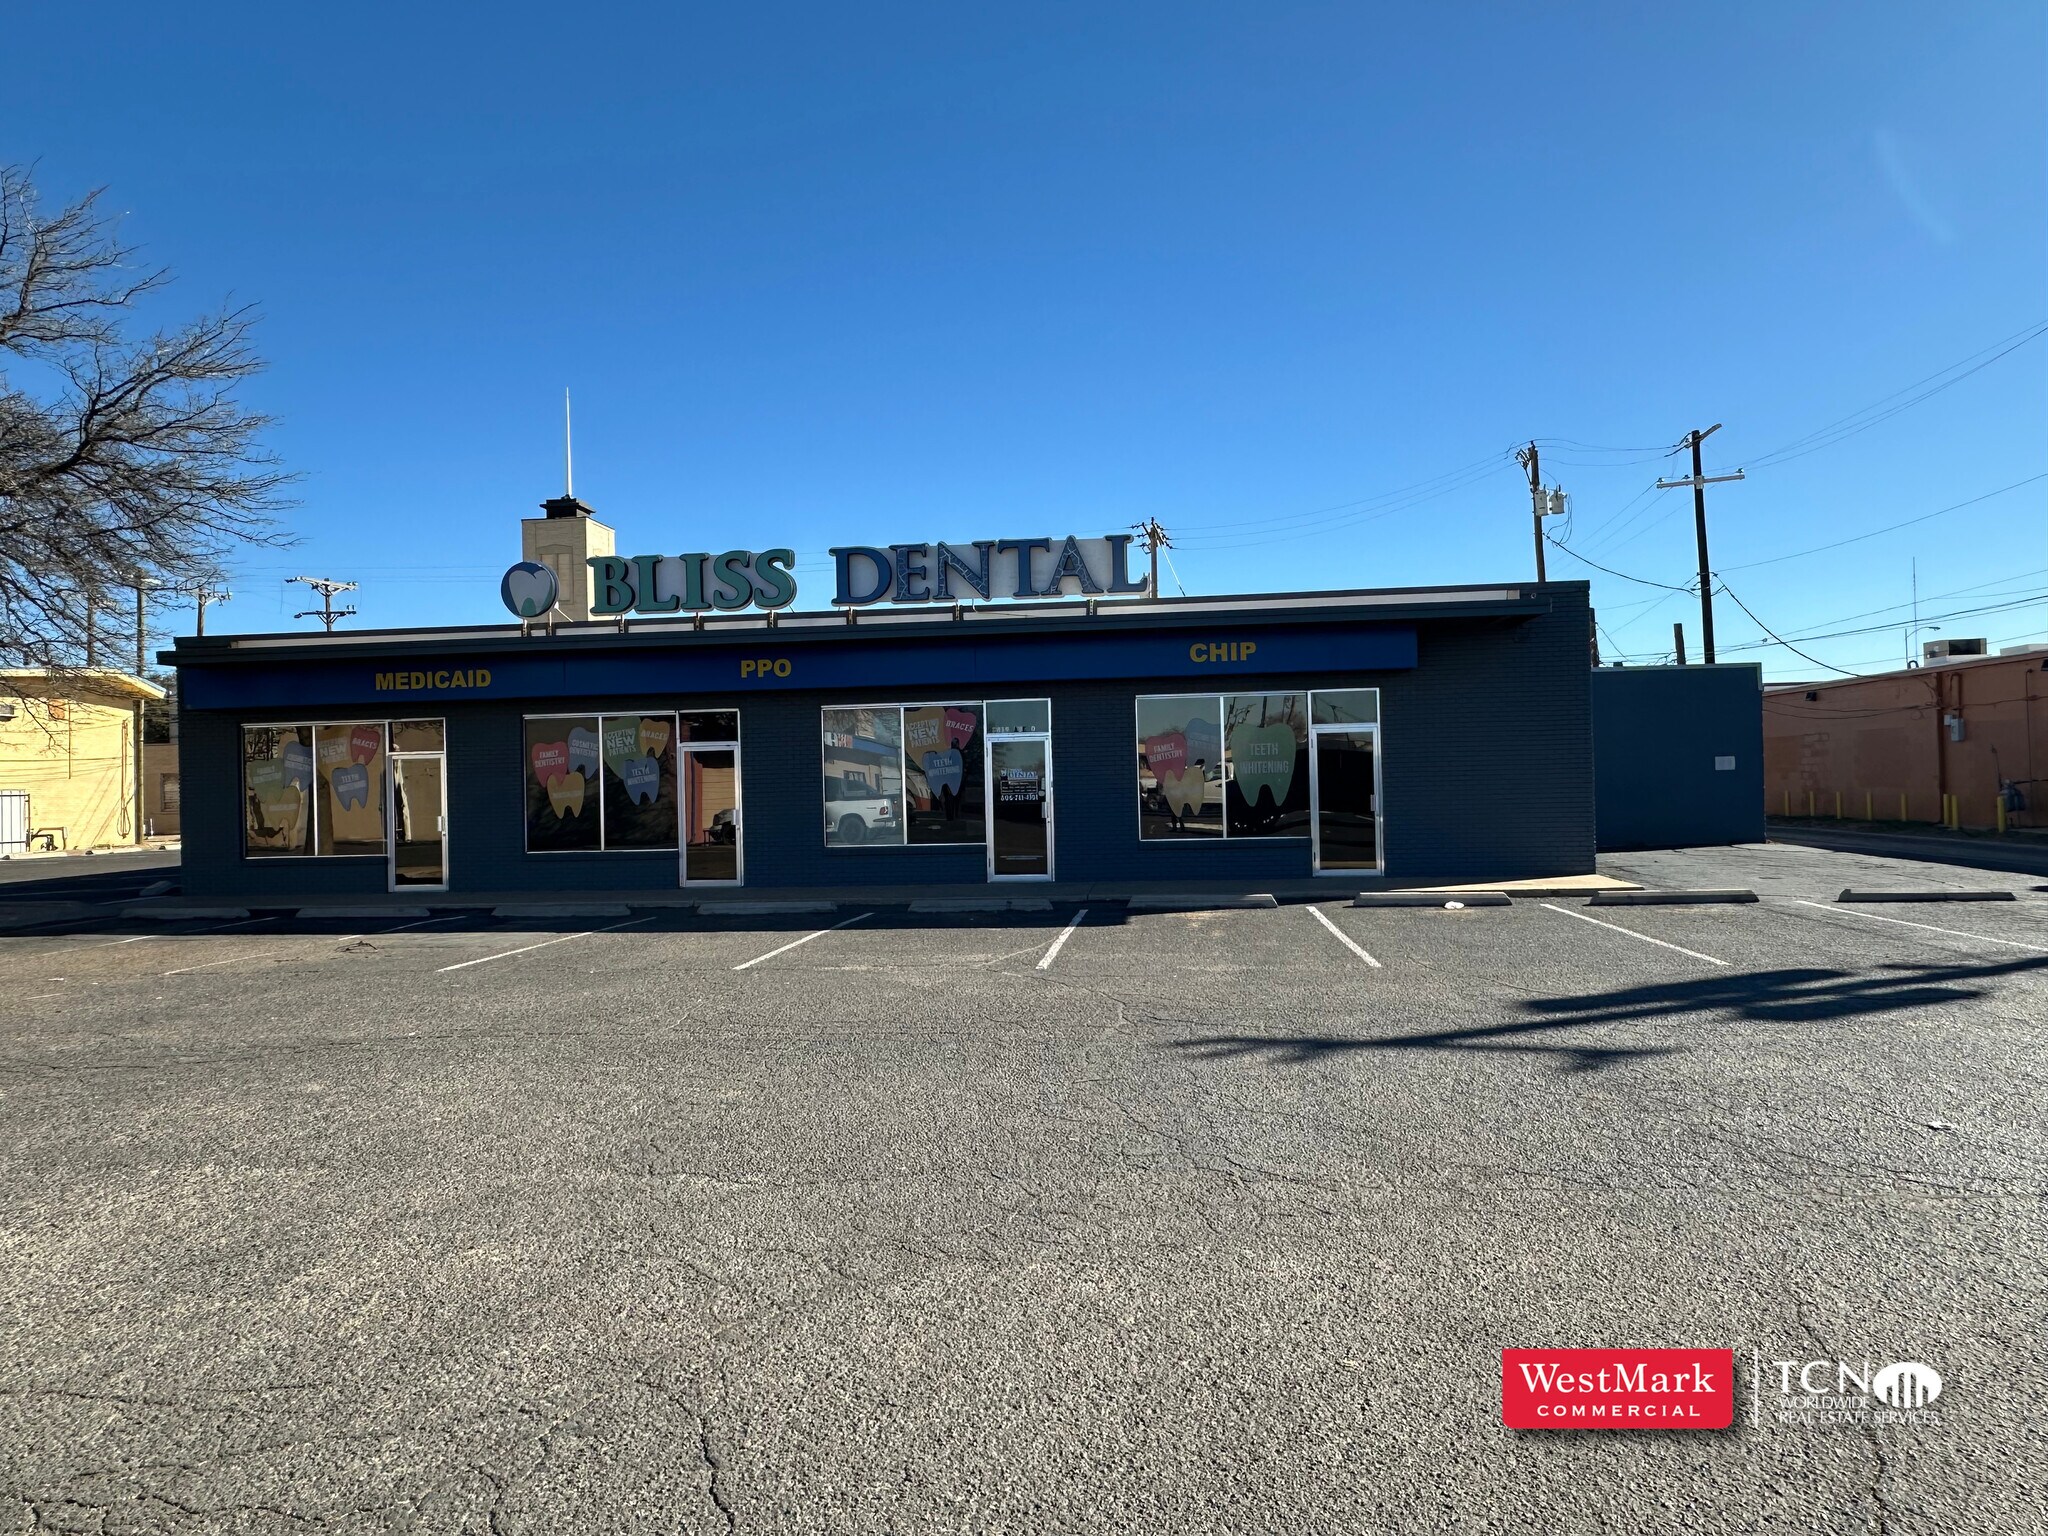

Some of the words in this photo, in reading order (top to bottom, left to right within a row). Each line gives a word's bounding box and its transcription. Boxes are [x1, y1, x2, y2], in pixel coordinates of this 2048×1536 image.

[586, 549, 797, 615] BLISS
[829, 534, 1150, 606] DENTAL
[1189, 641, 1257, 663] CHIP
[740, 658, 793, 678] PPO
[375, 669, 492, 690] MEDICAID
[908, 724, 938, 740] NEW
[945, 720, 974, 733] BRACES
[607, 735, 635, 750] NEW
[1153, 742, 1175, 753] FAMILY
[1249, 743, 1279, 756] TEETH
[319, 742, 348, 759] NEW
[539, 749, 559, 759] FAMILY
[535, 757, 565, 768] DENTISTRY
[1241, 760, 1289, 775] WHITENING
